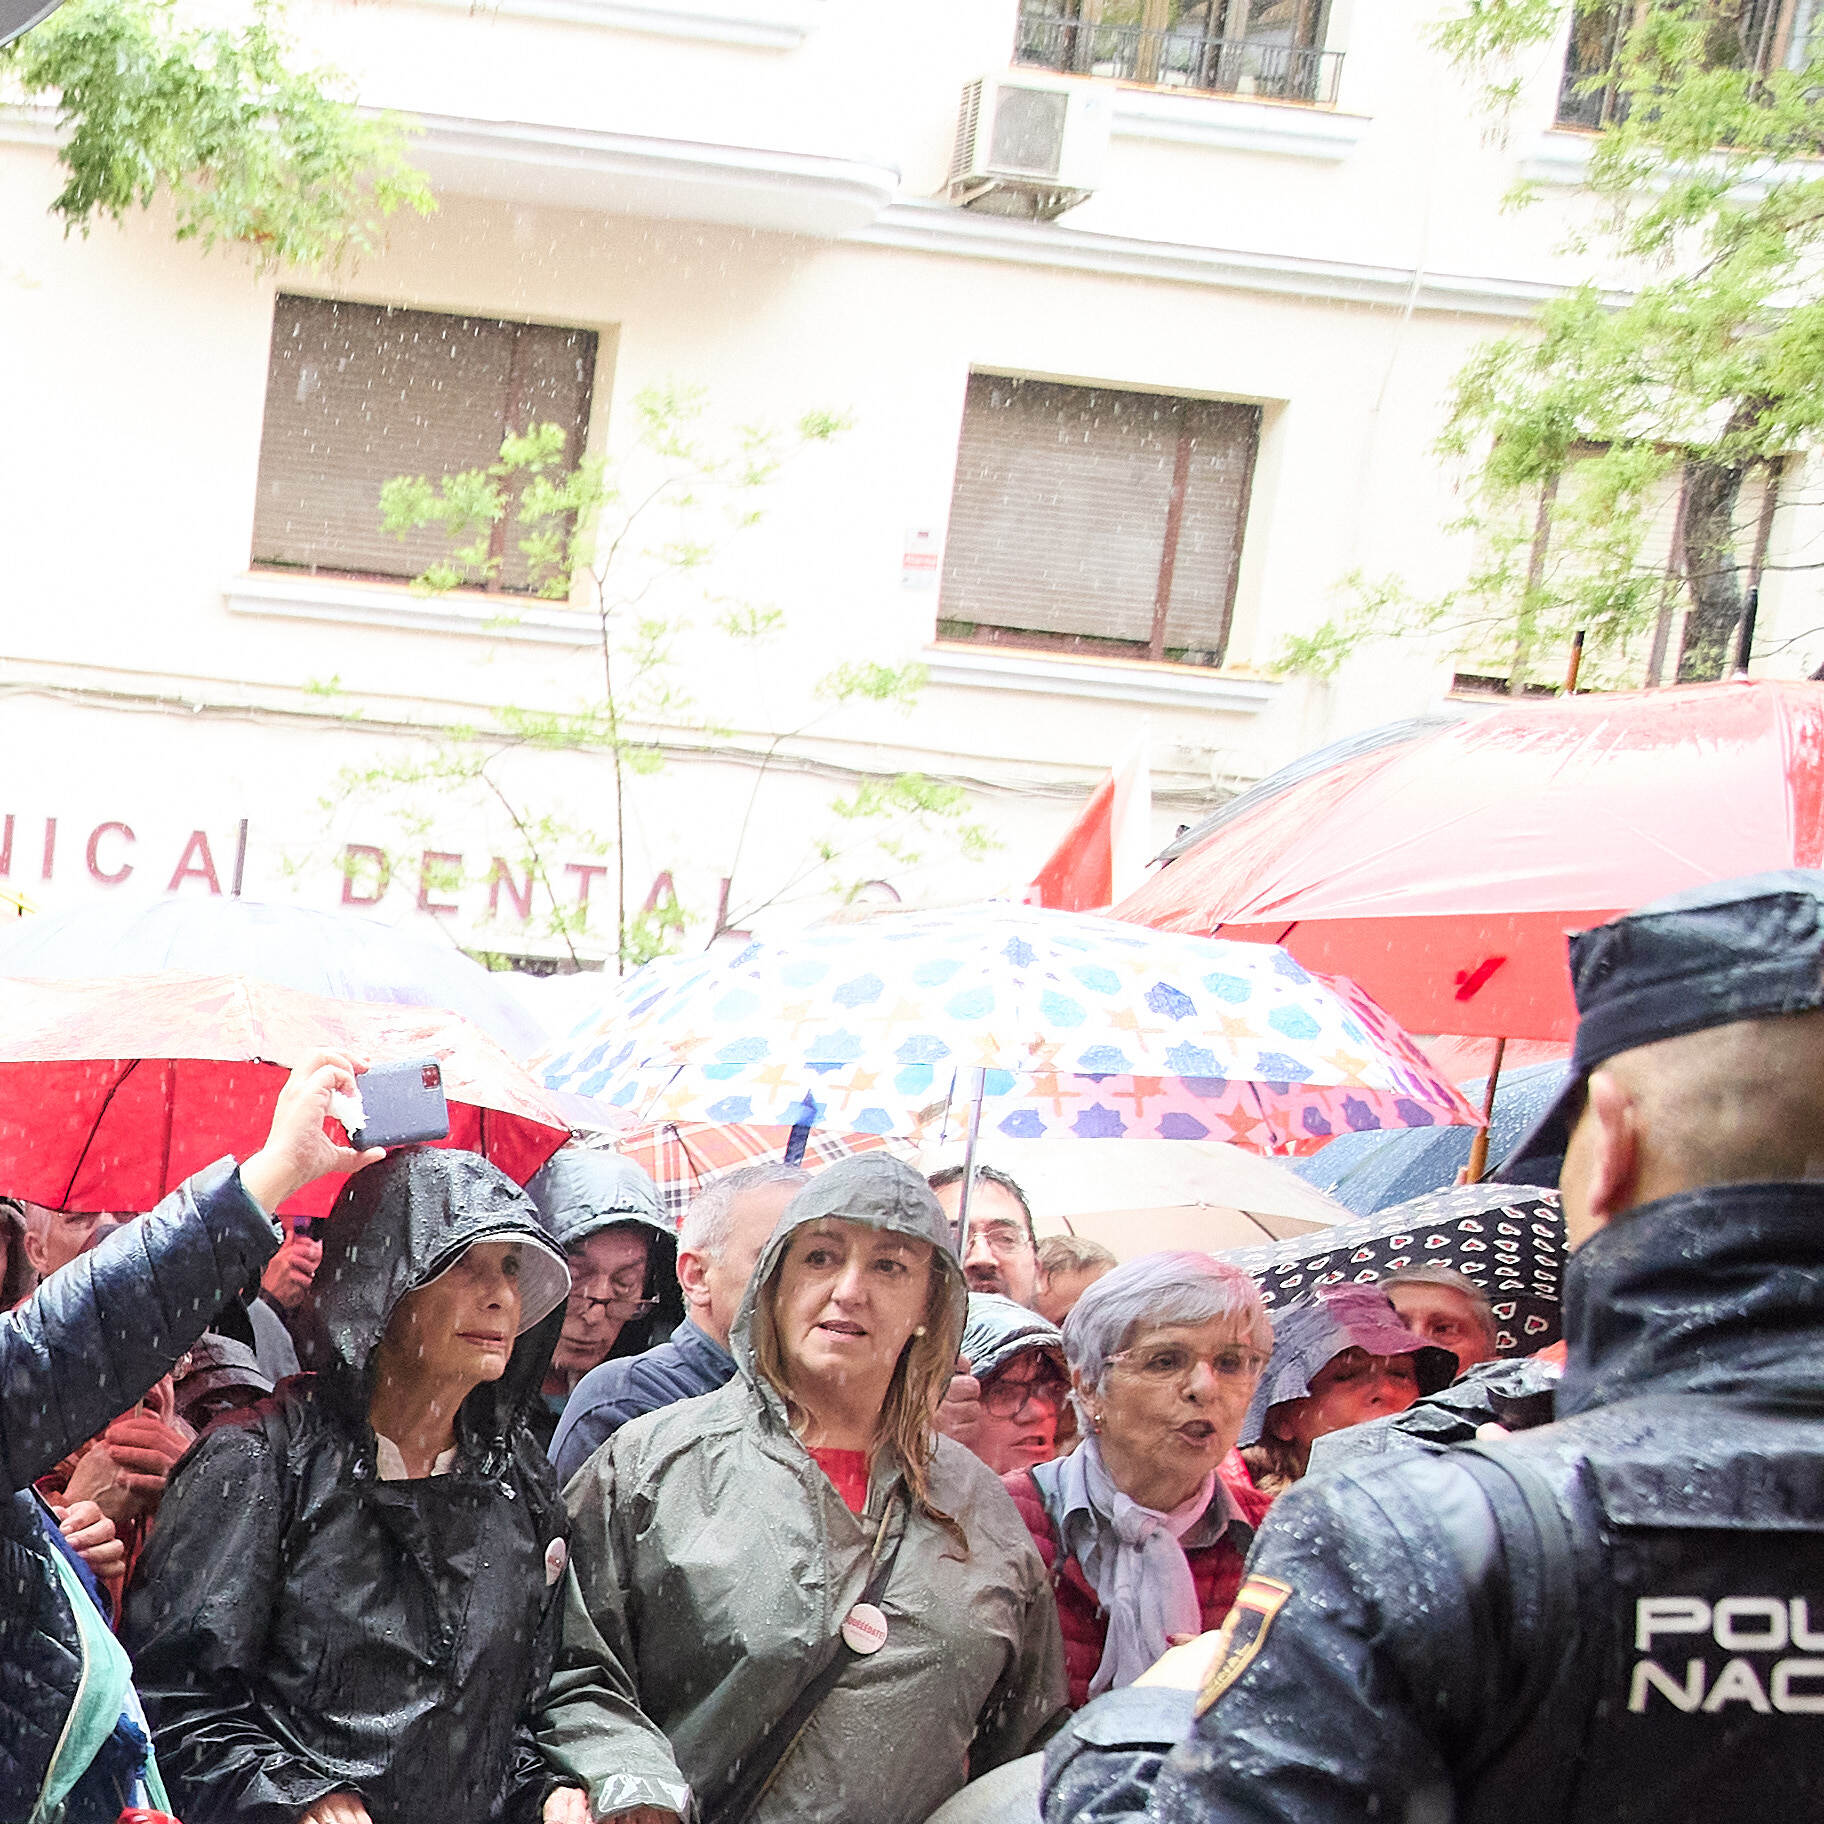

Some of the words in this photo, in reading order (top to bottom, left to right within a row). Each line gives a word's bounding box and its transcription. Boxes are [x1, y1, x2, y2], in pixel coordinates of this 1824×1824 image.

[341, 844, 753, 942] DENTAL
[1635, 1596, 1824, 1650] POL
[1627, 1658, 1824, 1713] NAC
